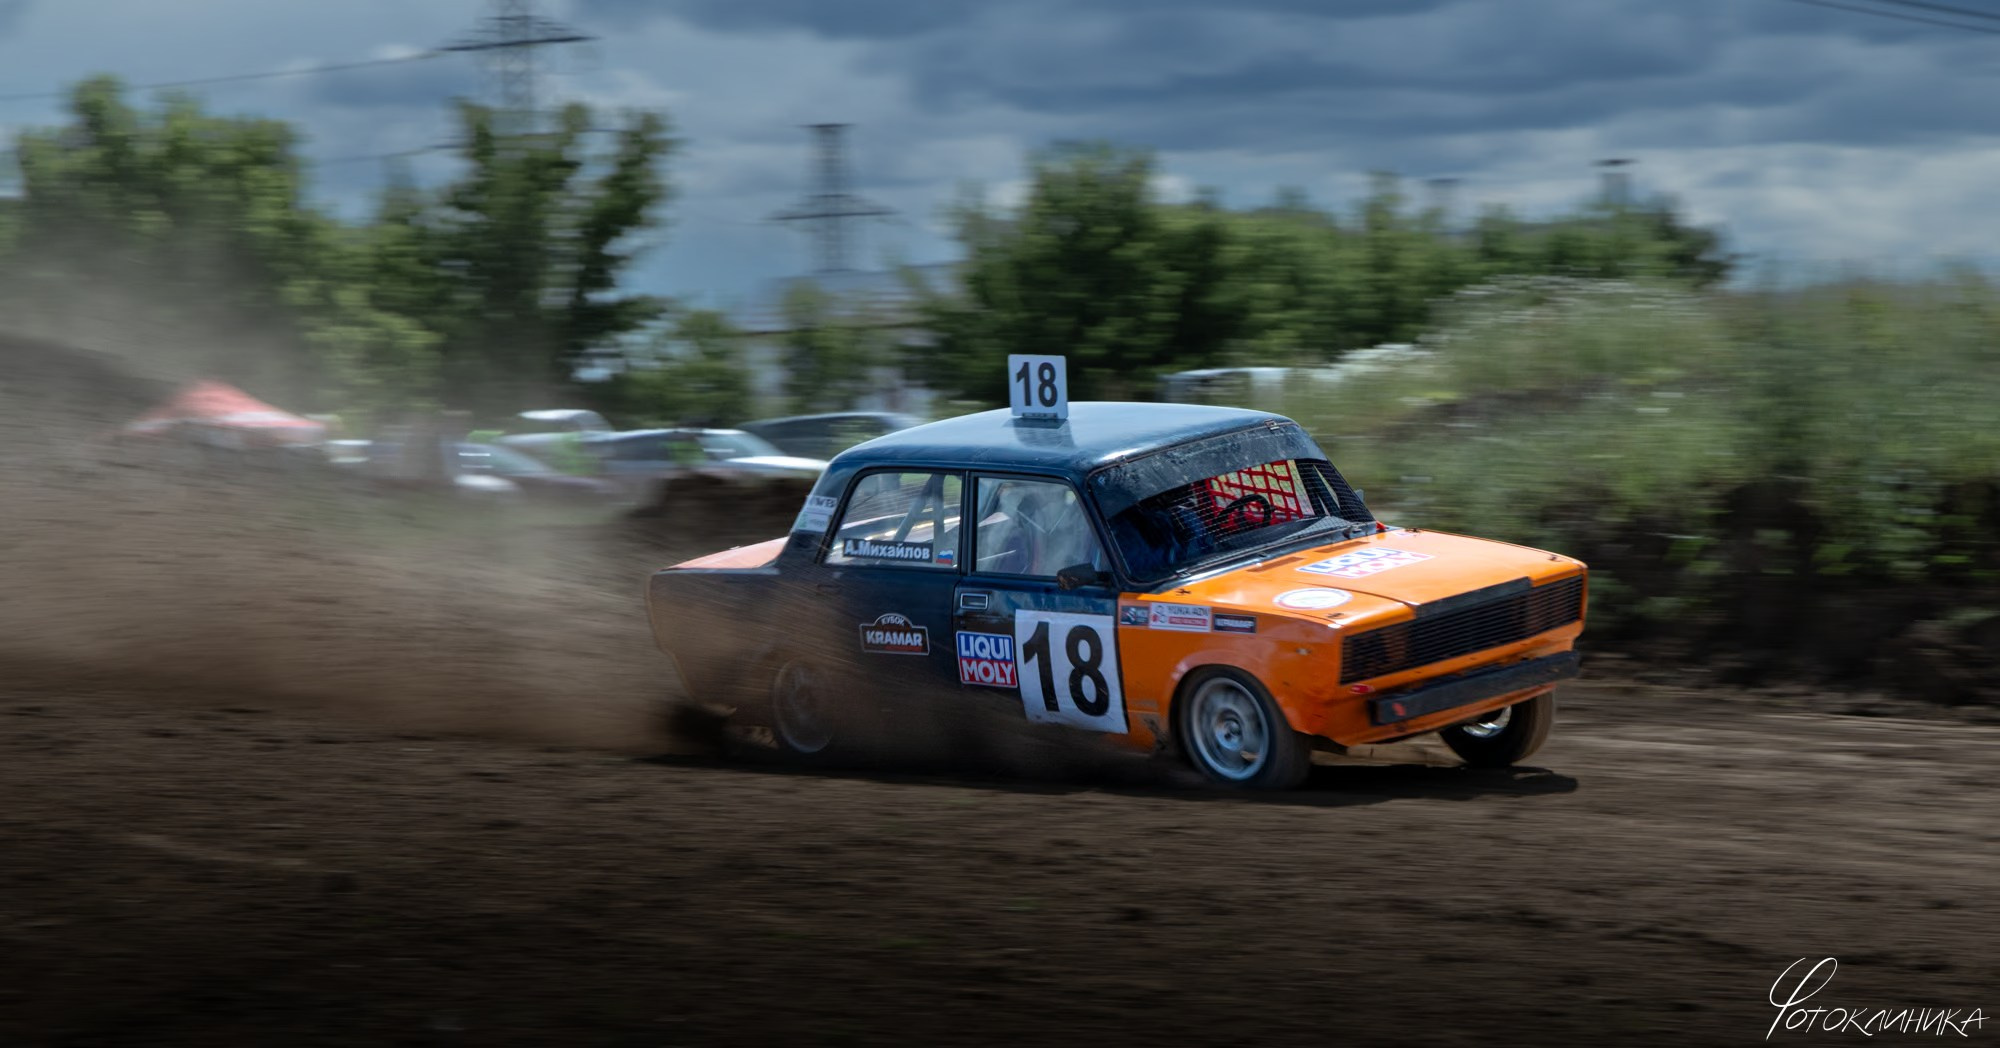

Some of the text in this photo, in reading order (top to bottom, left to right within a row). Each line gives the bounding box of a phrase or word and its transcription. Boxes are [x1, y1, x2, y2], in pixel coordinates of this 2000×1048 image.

[1016, 361, 1058, 408] 18
[845, 540, 930, 560] А.Михайлов
[865, 630, 923, 647] KRAMAR
[960, 635, 1010, 661] LIQUI
[961, 660, 1014, 685] MOLY
[1022, 621, 1110, 717] 18
